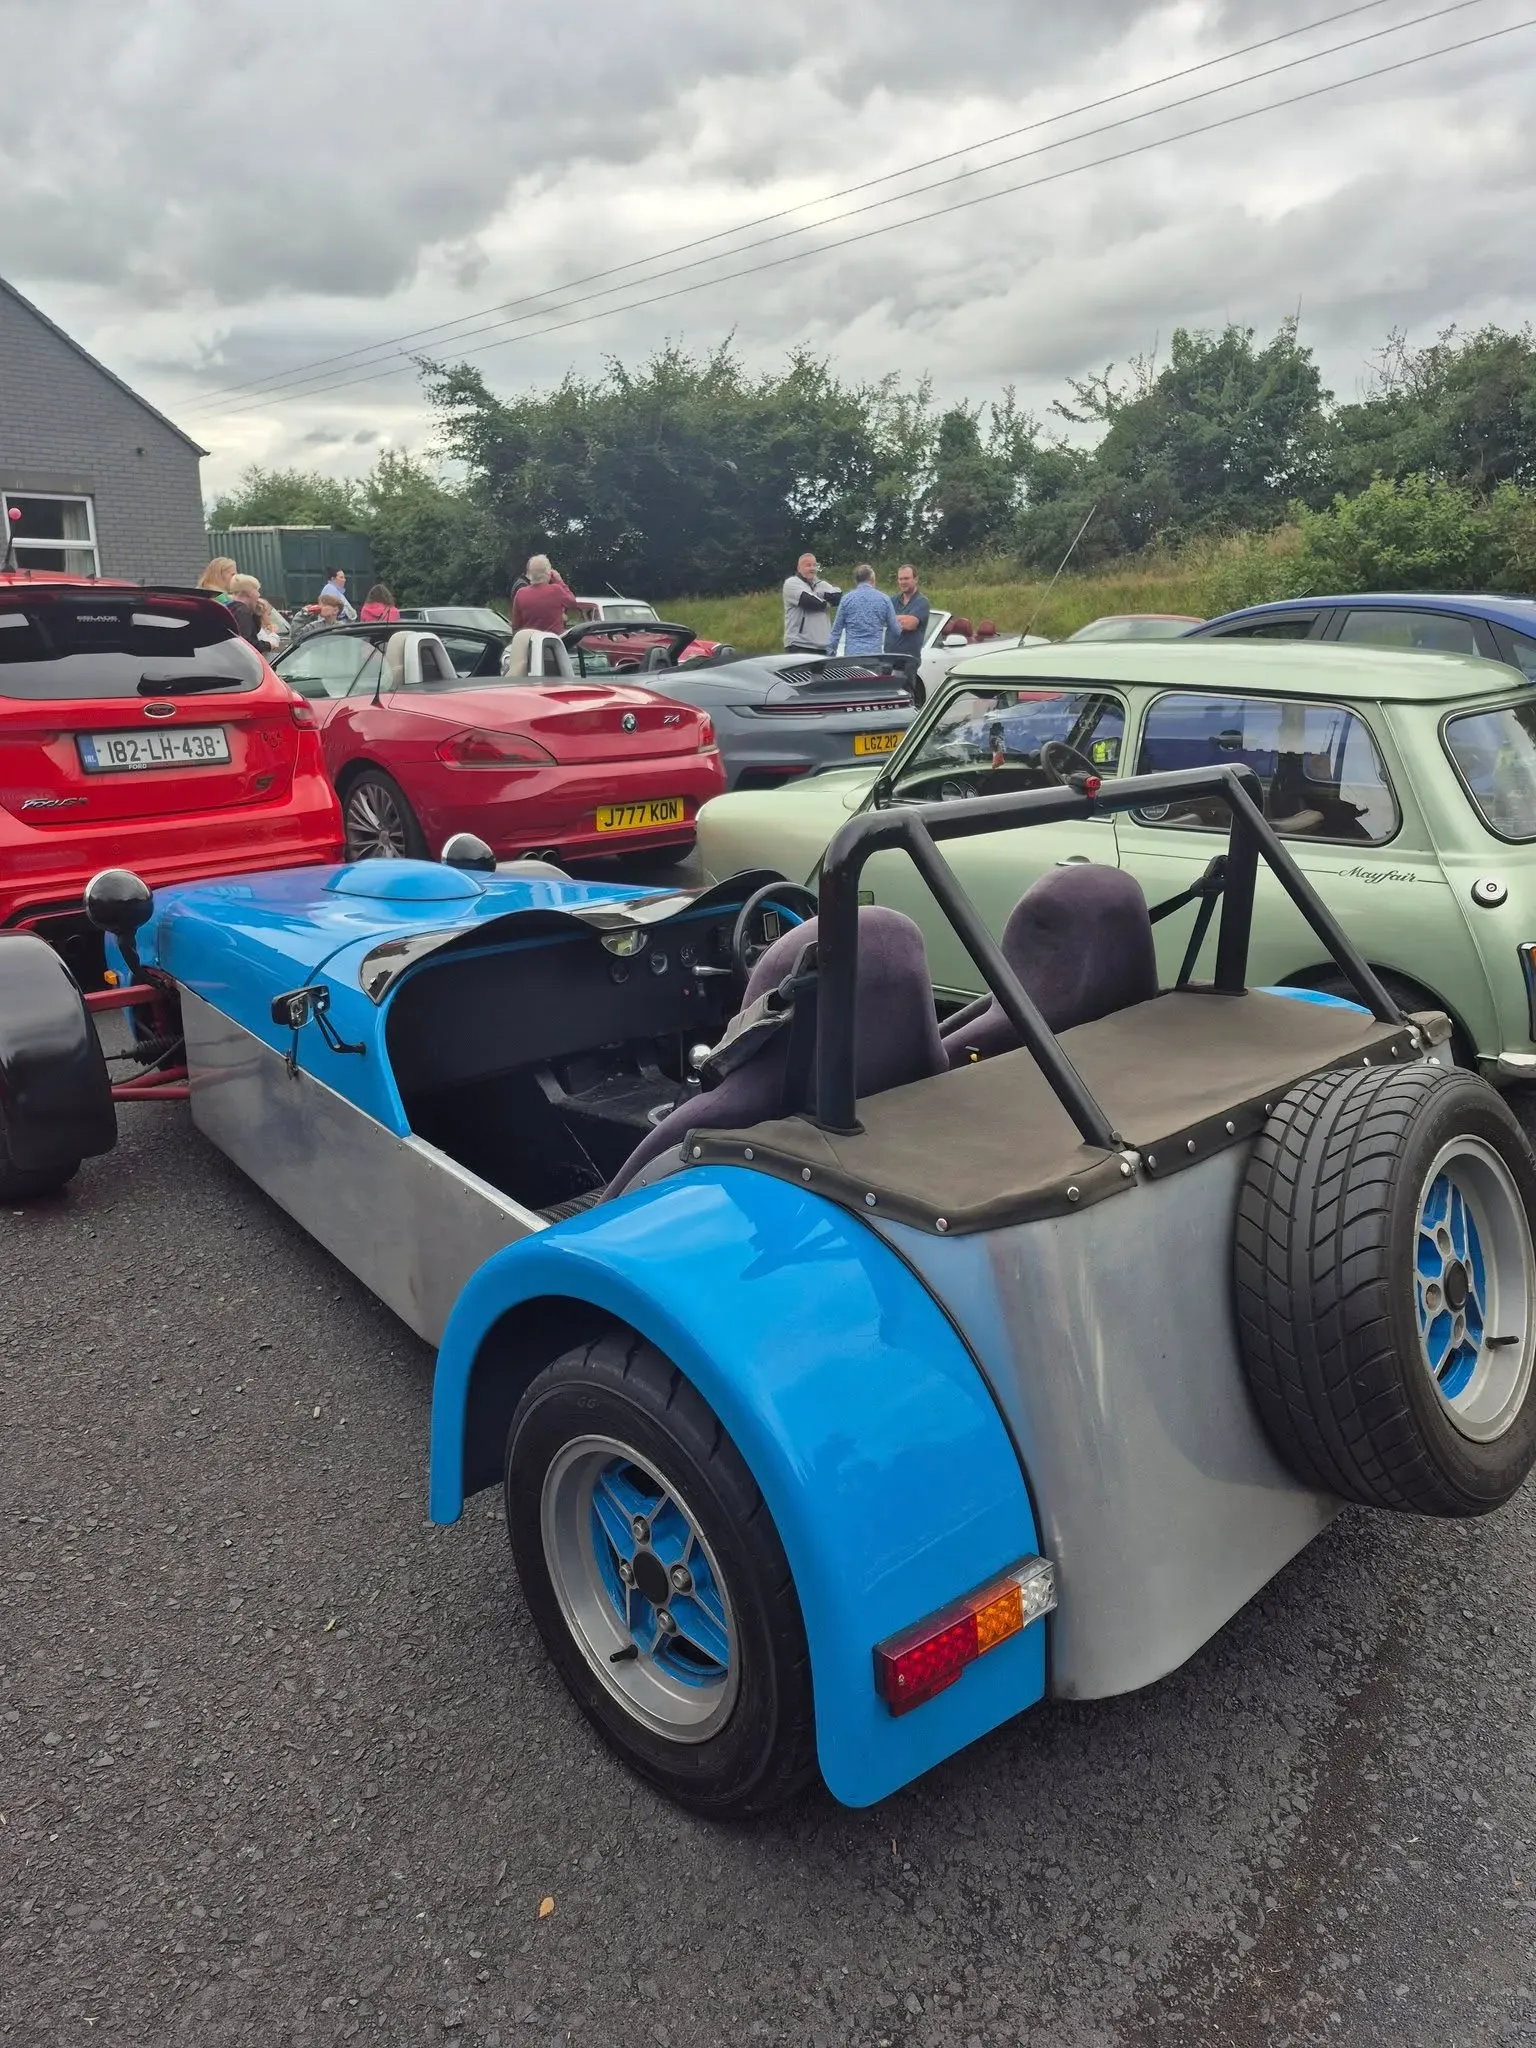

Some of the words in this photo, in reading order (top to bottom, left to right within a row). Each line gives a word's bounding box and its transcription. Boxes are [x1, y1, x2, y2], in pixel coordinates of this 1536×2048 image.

[663, 714, 681, 724] Z4
[107, 736, 216, 763] 182-LH-438
[864, 736, 882, 751] LGZ
[604, 805, 646, 827] J777
[650, 801, 678, 822] KON
[1338, 866, 1416, 884] Mayfair
